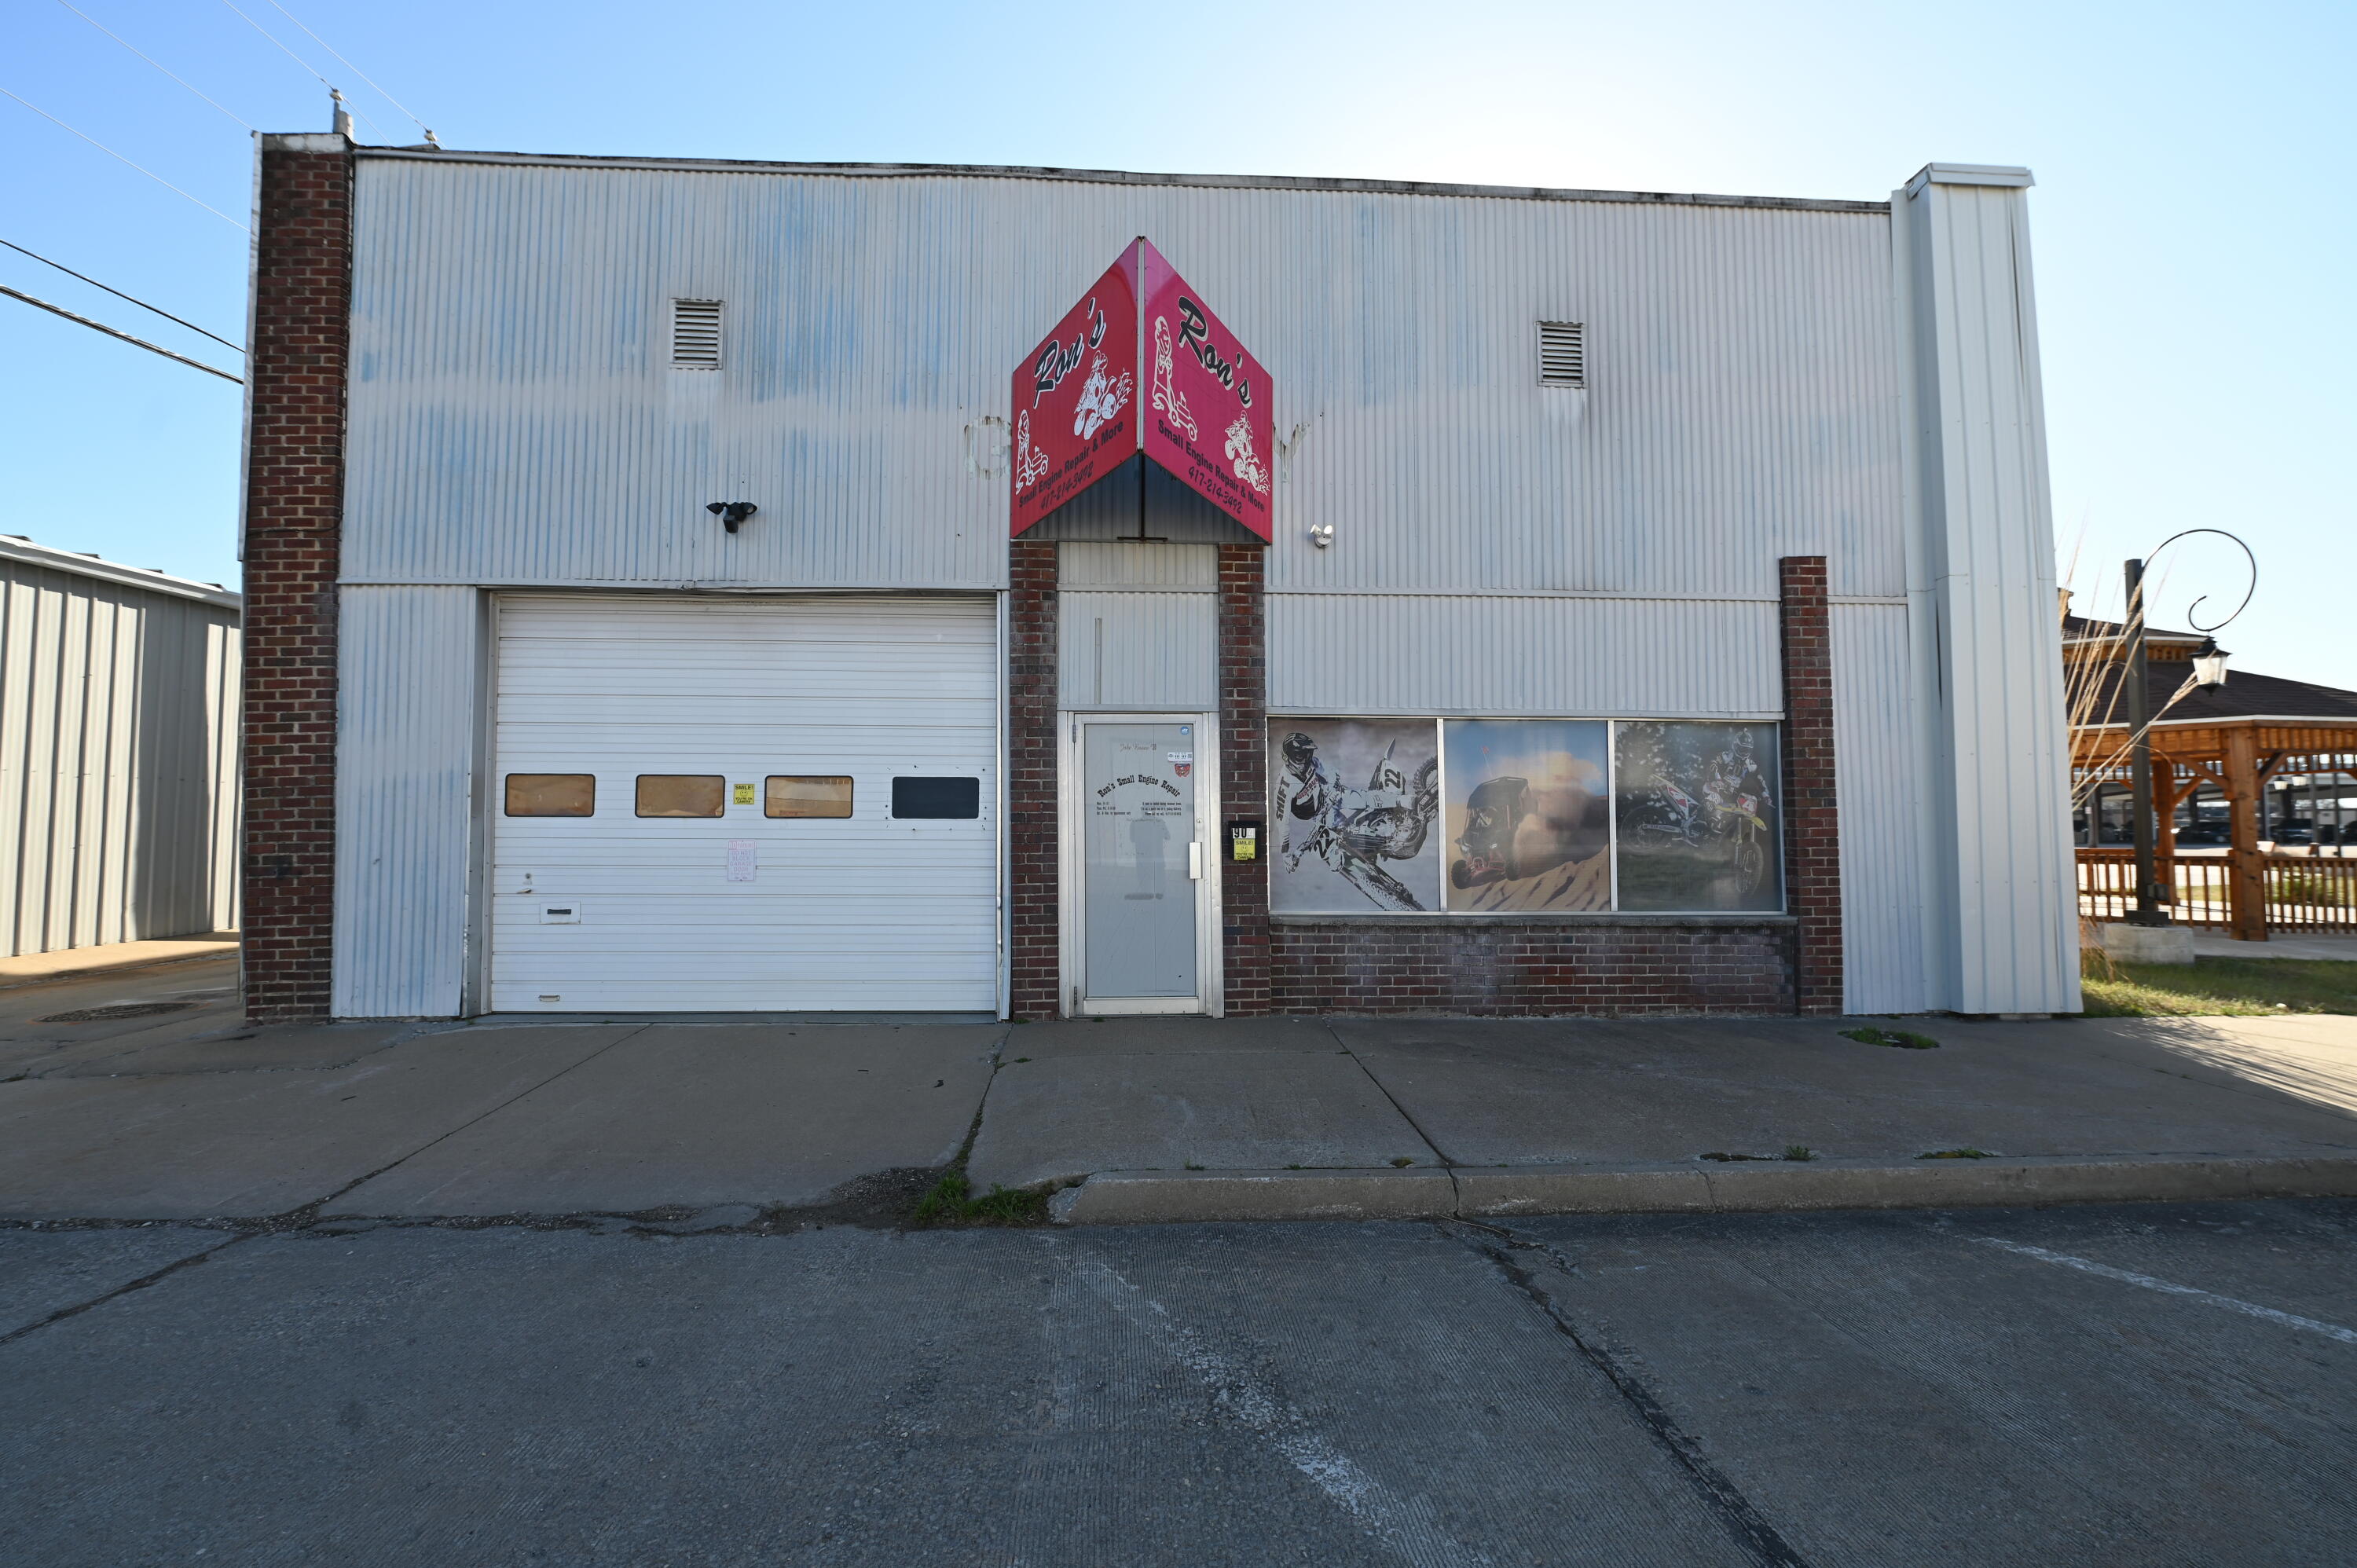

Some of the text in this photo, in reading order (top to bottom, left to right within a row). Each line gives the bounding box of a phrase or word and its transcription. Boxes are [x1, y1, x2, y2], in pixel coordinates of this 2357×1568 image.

[1033, 298, 1106, 409] Ron's
[1178, 295, 1252, 408] Ron's
[1019, 421, 1124, 507] Small Engine Repair & More
[1040, 460, 1094, 509] 417-214-3492
[1158, 419, 1265, 512] Small Engine Repair & More
[1189, 466, 1242, 514] 417-214-3492
[1097, 775, 1180, 797] Ron's Small Engine Repair
[1276, 776, 1290, 821] SHIFT
[1384, 768, 1401, 789] 22
[1314, 829, 1335, 858] 22
